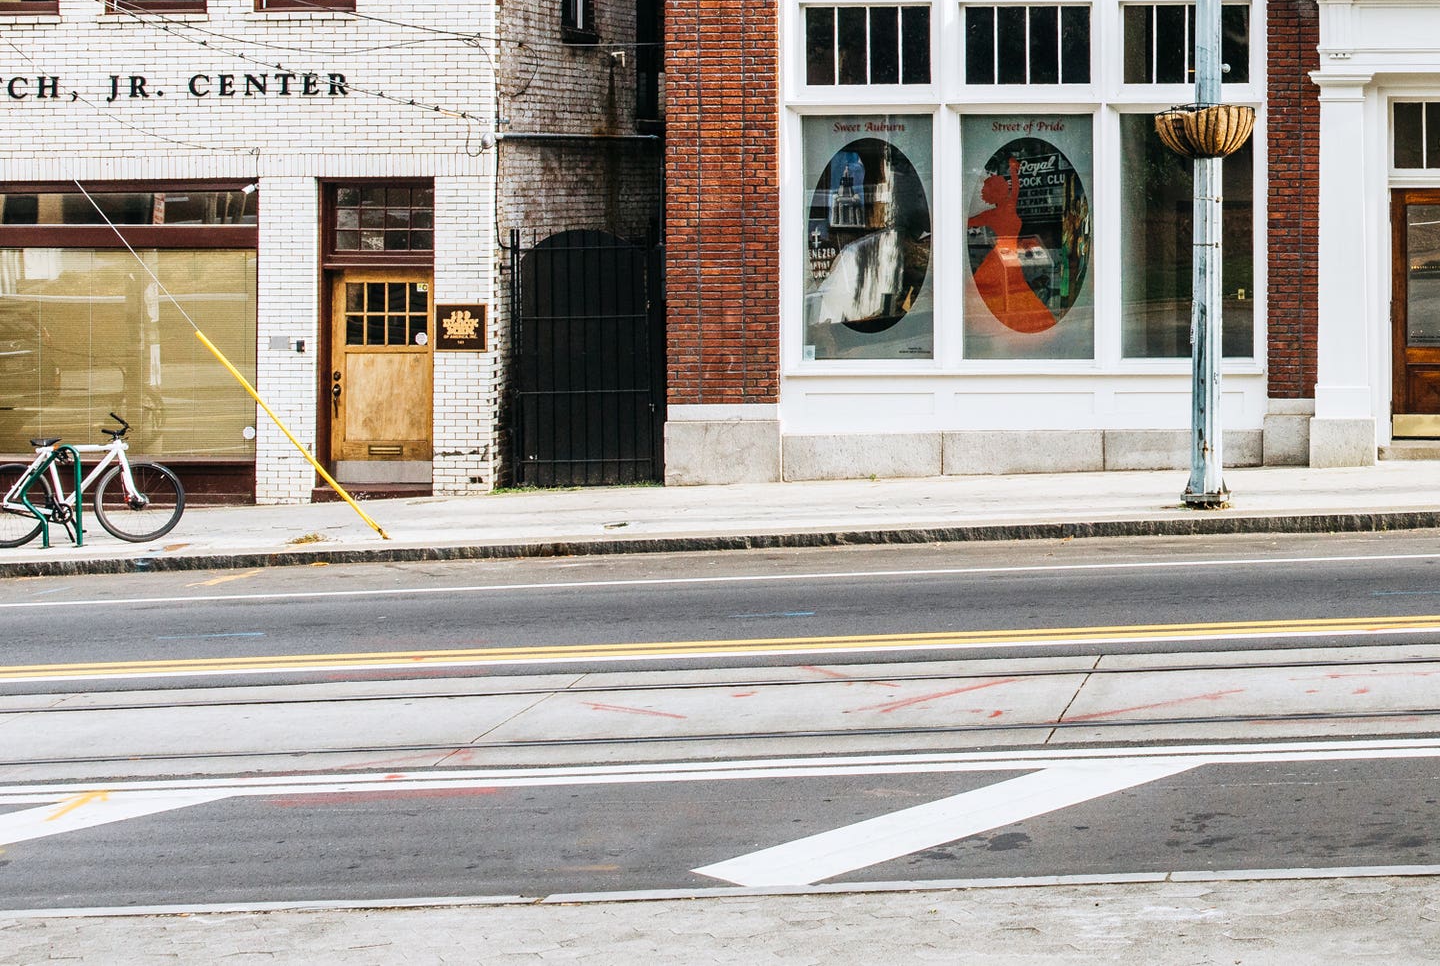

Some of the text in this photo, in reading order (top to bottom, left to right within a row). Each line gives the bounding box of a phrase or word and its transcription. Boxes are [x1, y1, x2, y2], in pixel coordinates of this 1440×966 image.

[0, 72, 350, 101] CH, JR. CENTER
[833, 120, 905, 133] Sweet Auburn
[992, 119, 1065, 136] Street of Pride
[1017, 155, 1056, 176] Royal
